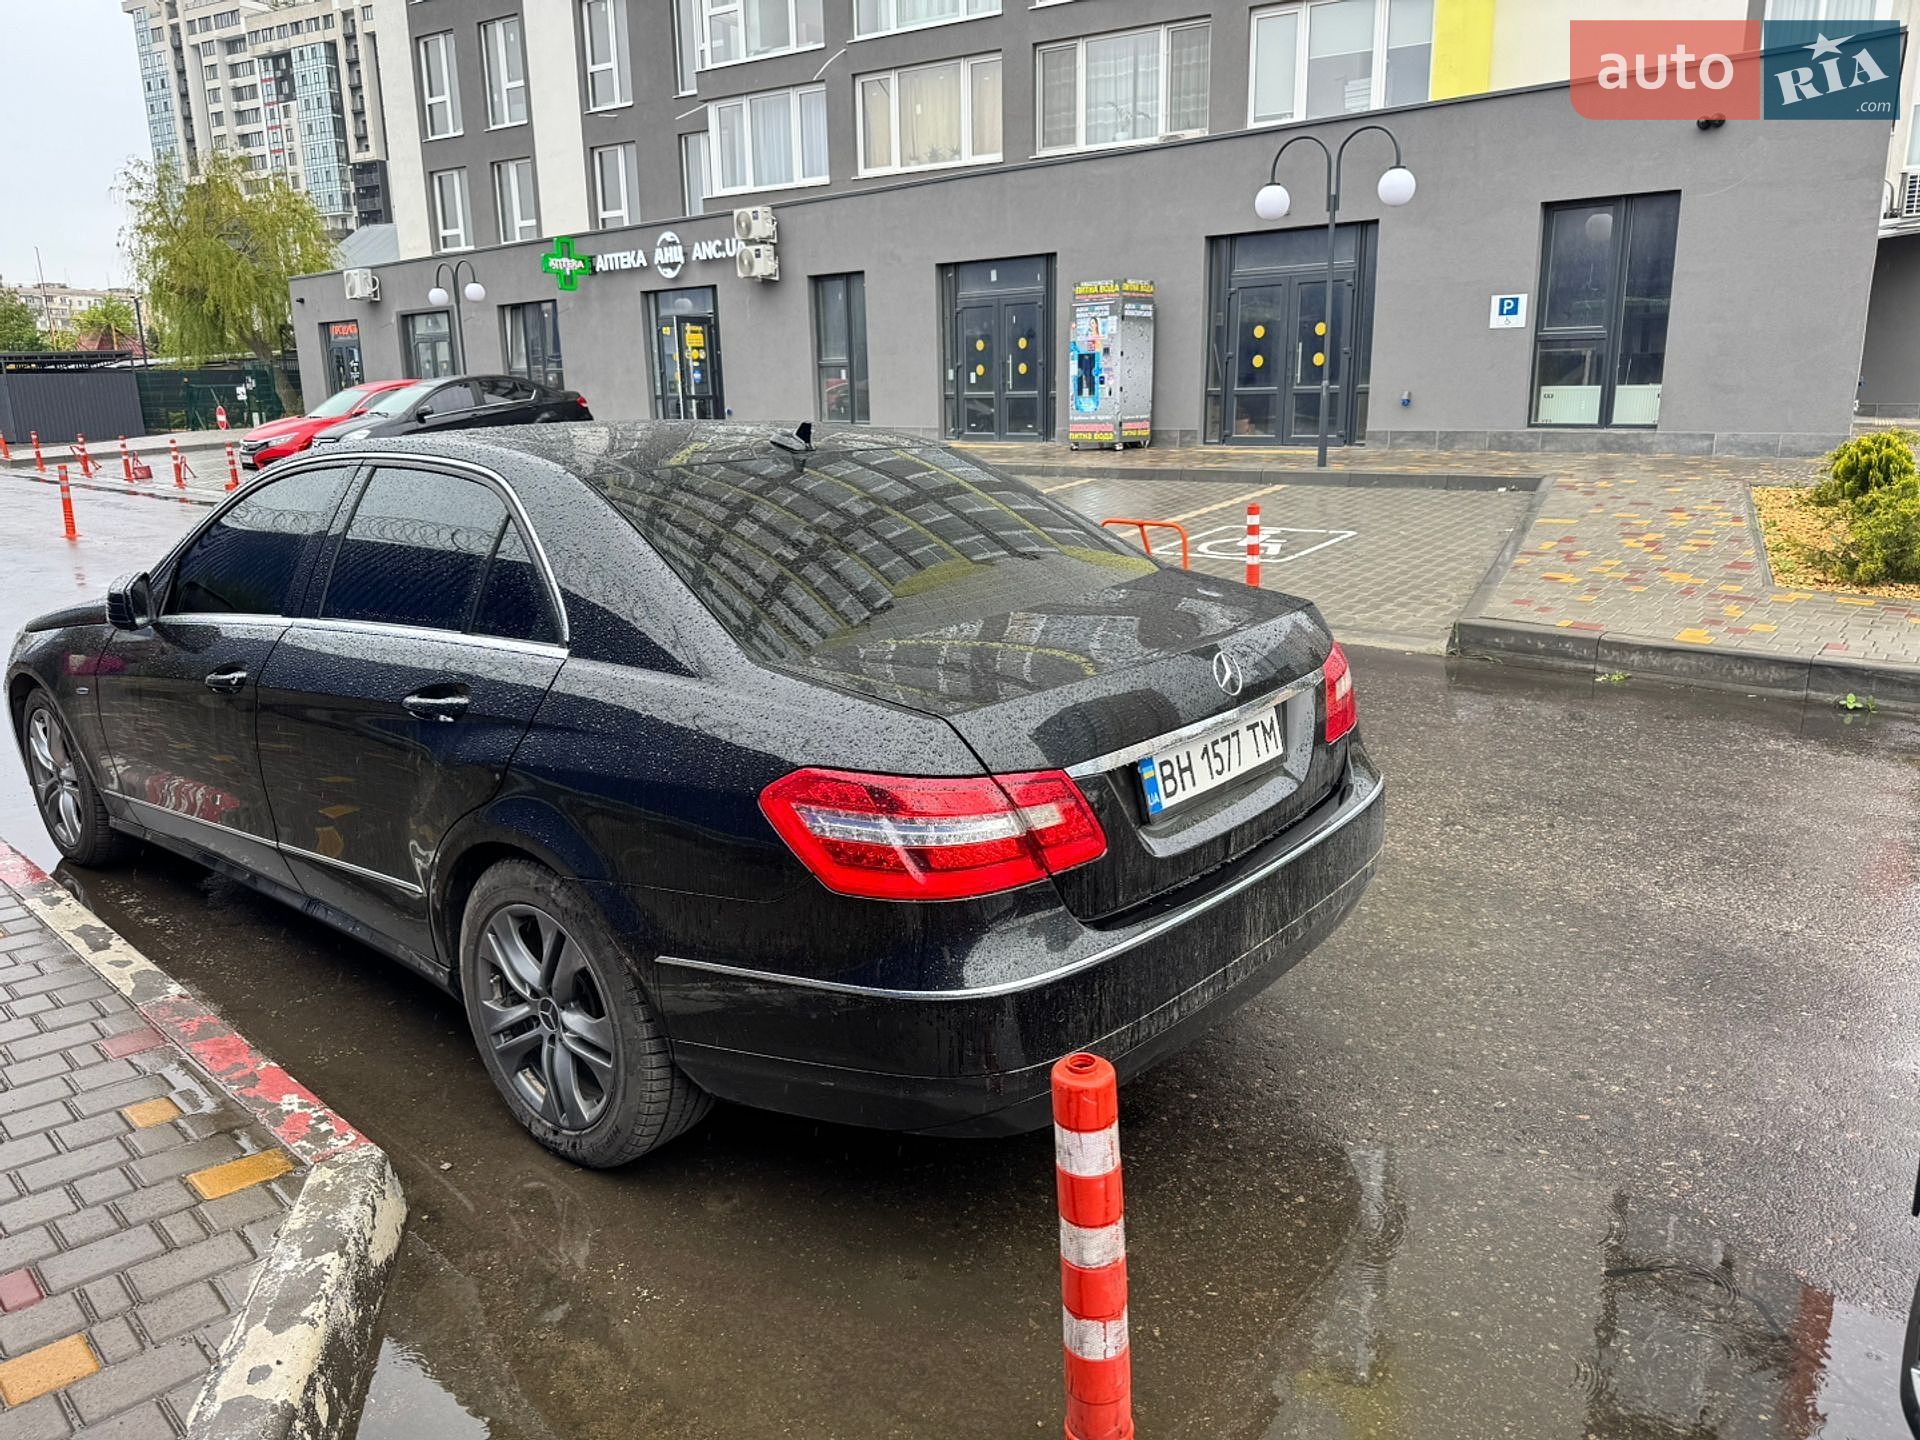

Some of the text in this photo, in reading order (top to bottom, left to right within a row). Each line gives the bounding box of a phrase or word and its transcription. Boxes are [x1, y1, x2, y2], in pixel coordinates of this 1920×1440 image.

[596, 250, 647, 272] АПТЕКА
[1503, 299, 1514, 315] P
[1159, 716, 1279, 798] BH 1577 TM
